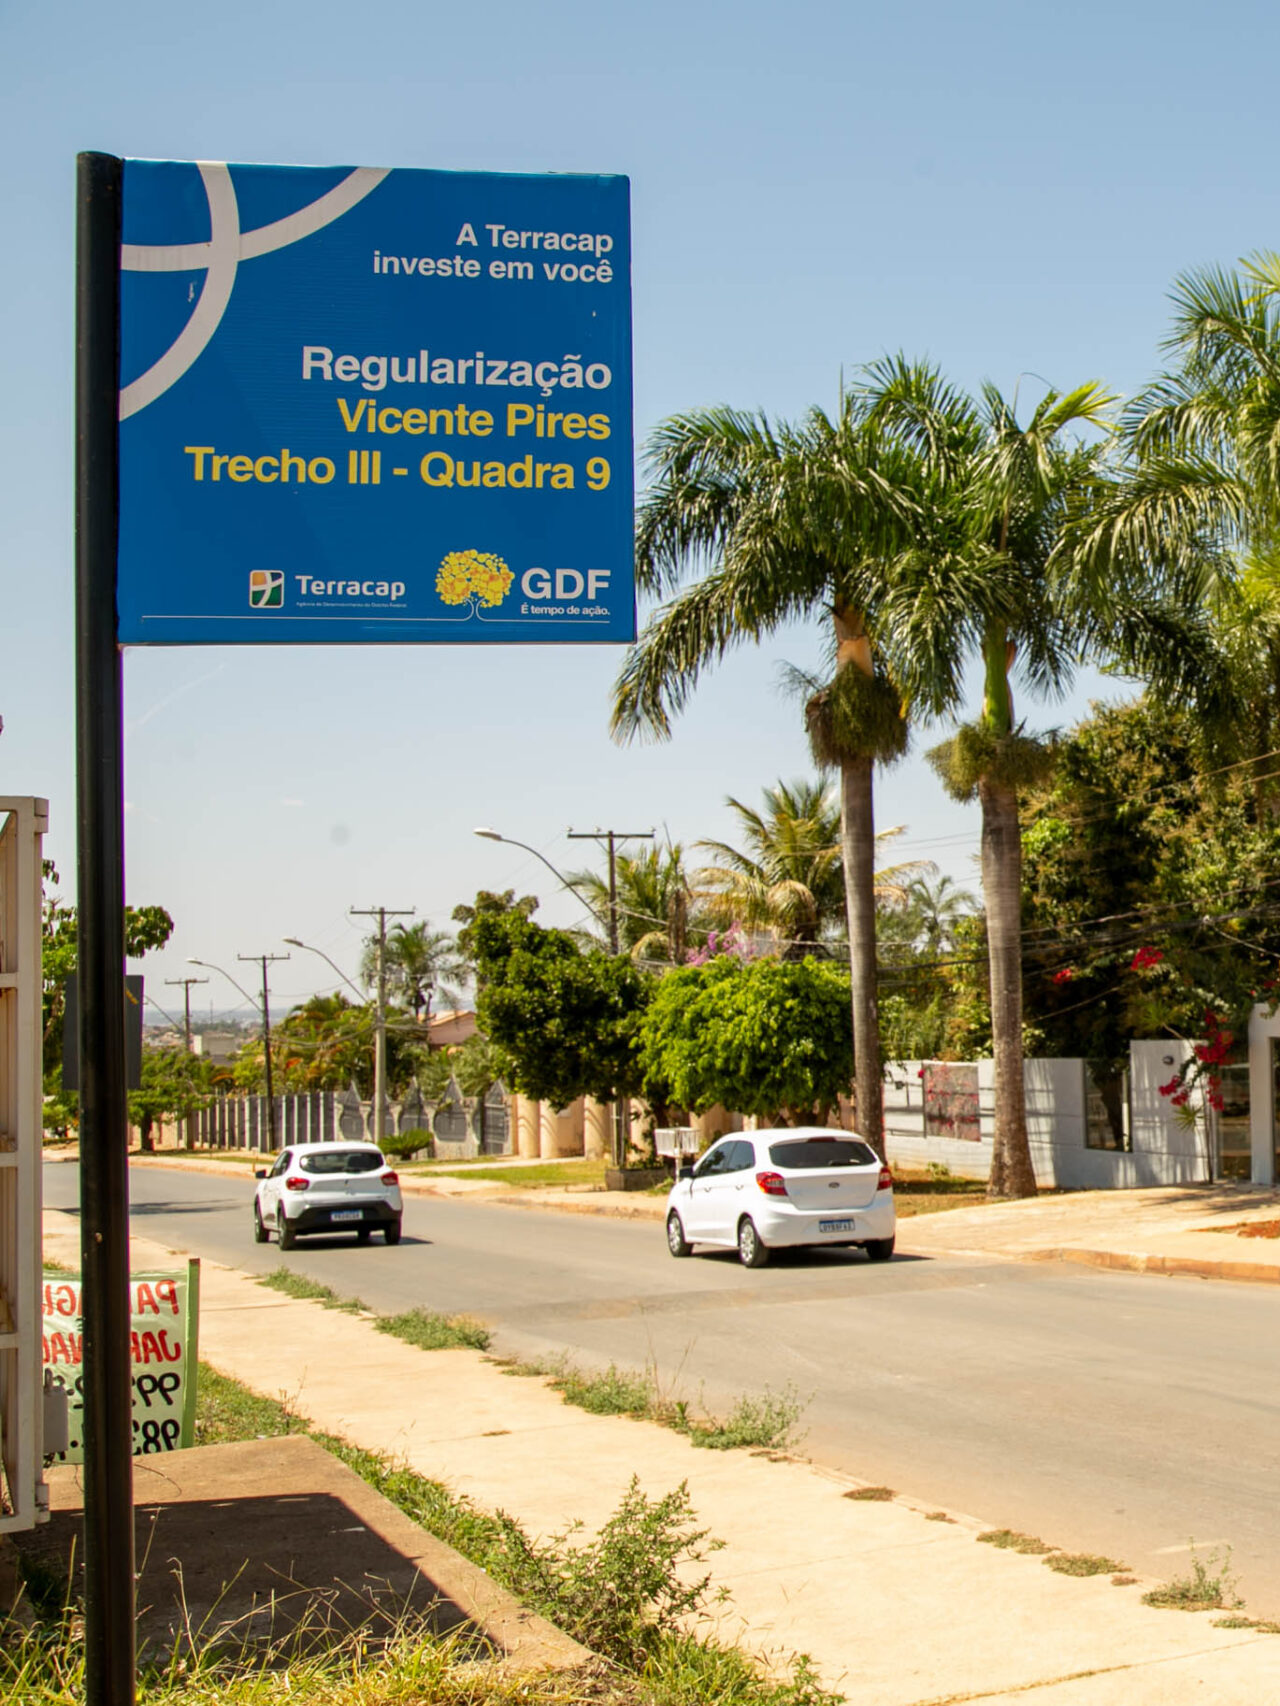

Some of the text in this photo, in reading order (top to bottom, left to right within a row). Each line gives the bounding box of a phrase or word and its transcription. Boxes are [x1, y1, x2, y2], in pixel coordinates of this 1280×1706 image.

[455, 223, 613, 256] A Terracap
[373, 250, 613, 283] investe em você
[302, 345, 612, 396] Regularização
[336, 398, 611, 440] Vicente Pires
[184, 446, 611, 491] Trecho III - Quadra 9
[294, 575, 406, 601] Terracap
[521, 568, 611, 600] GDF
[520, 602, 611, 617] É tempo de ação.
